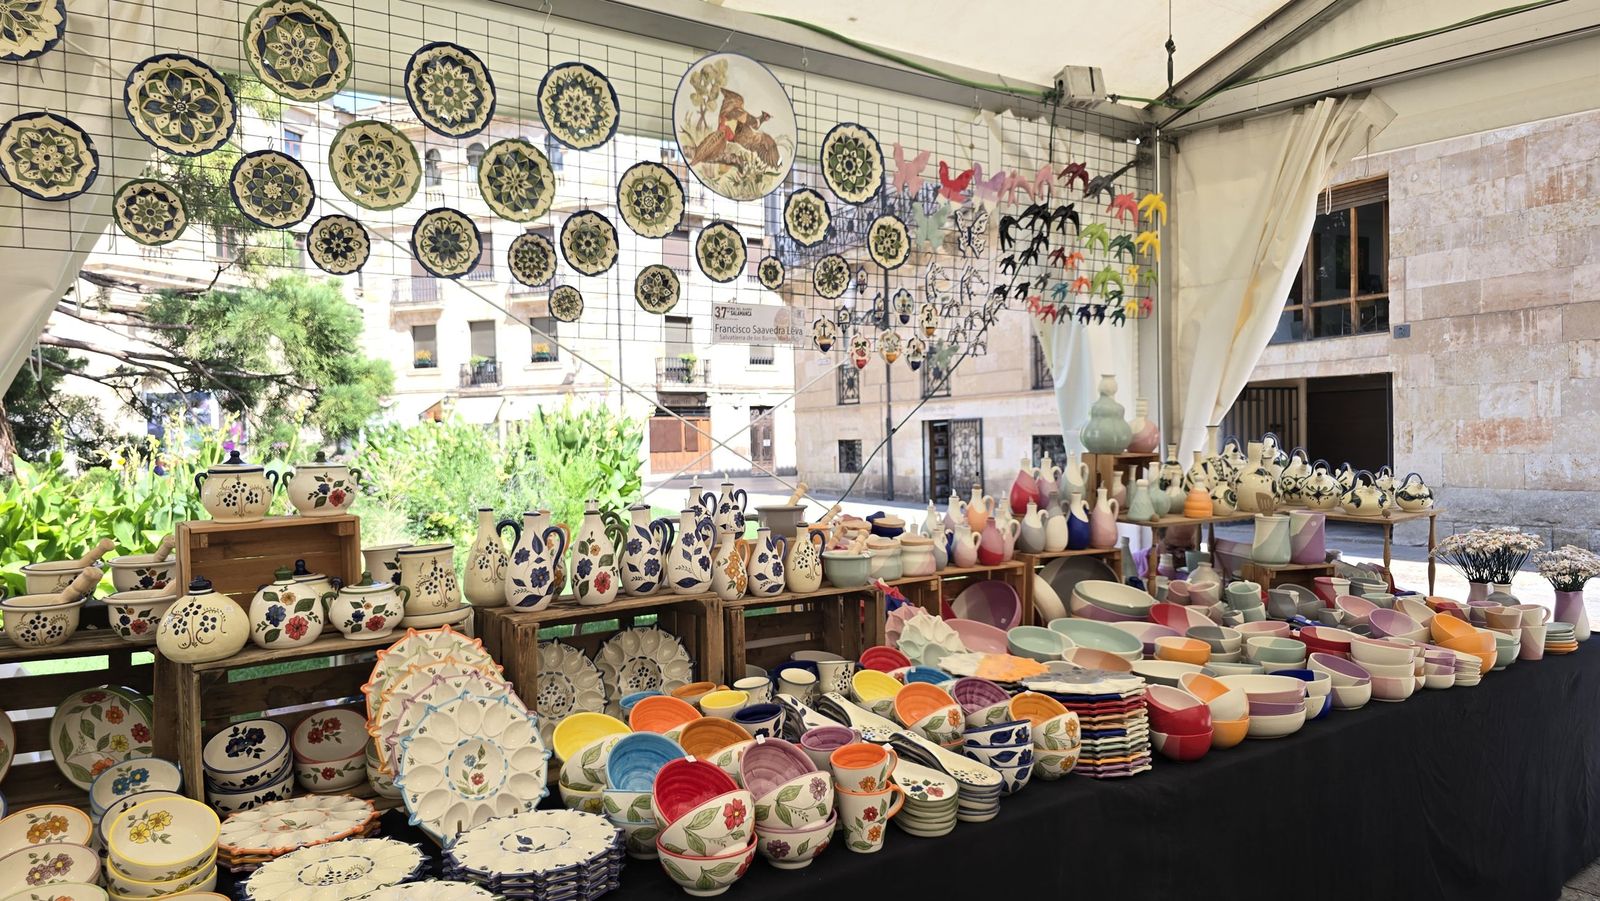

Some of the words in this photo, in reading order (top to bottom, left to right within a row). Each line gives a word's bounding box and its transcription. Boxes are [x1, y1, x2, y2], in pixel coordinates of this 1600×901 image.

[714, 306, 727, 319] 37
[714, 323, 751, 334] Francisco
[752, 325, 785, 335] Saavedra
